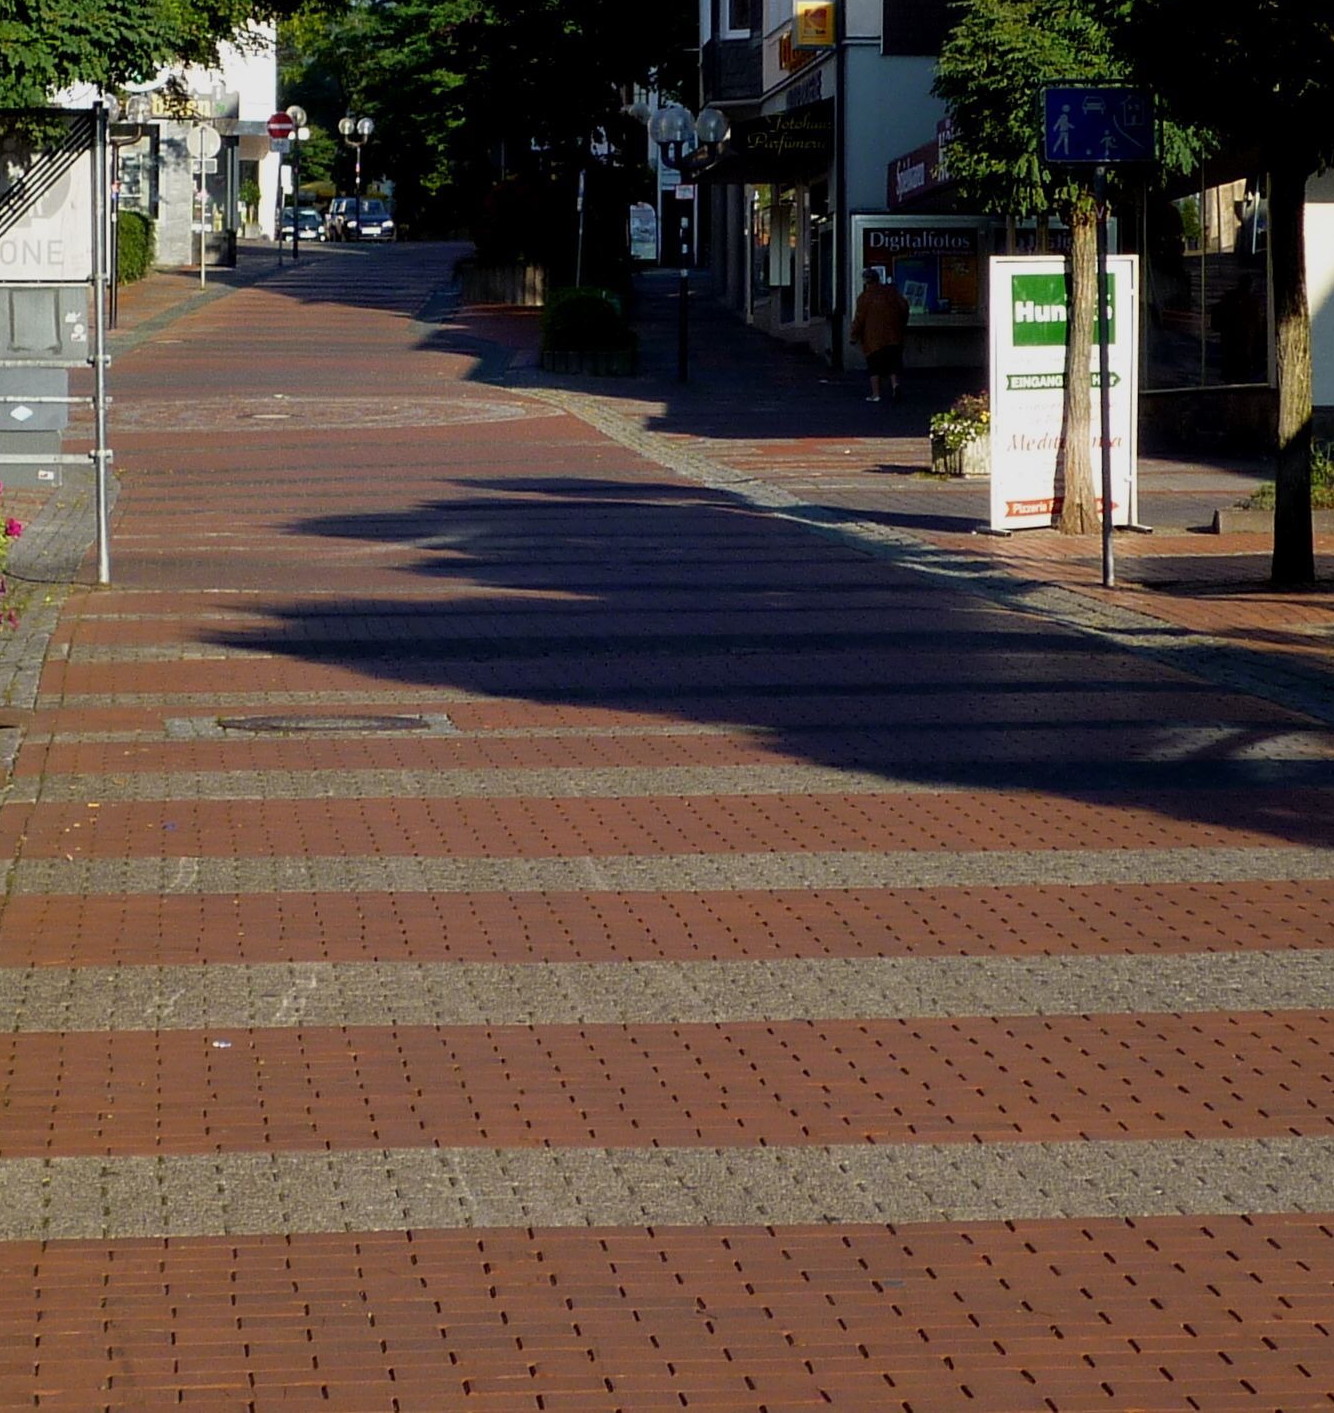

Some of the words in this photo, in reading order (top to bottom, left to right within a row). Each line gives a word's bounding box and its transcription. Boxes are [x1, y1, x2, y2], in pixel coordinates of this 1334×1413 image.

[869, 230, 970, 252] Digitalfotos
[1011, 374, 1063, 389] EINGANG
[1013, 503, 1047, 515] Pizzeria
